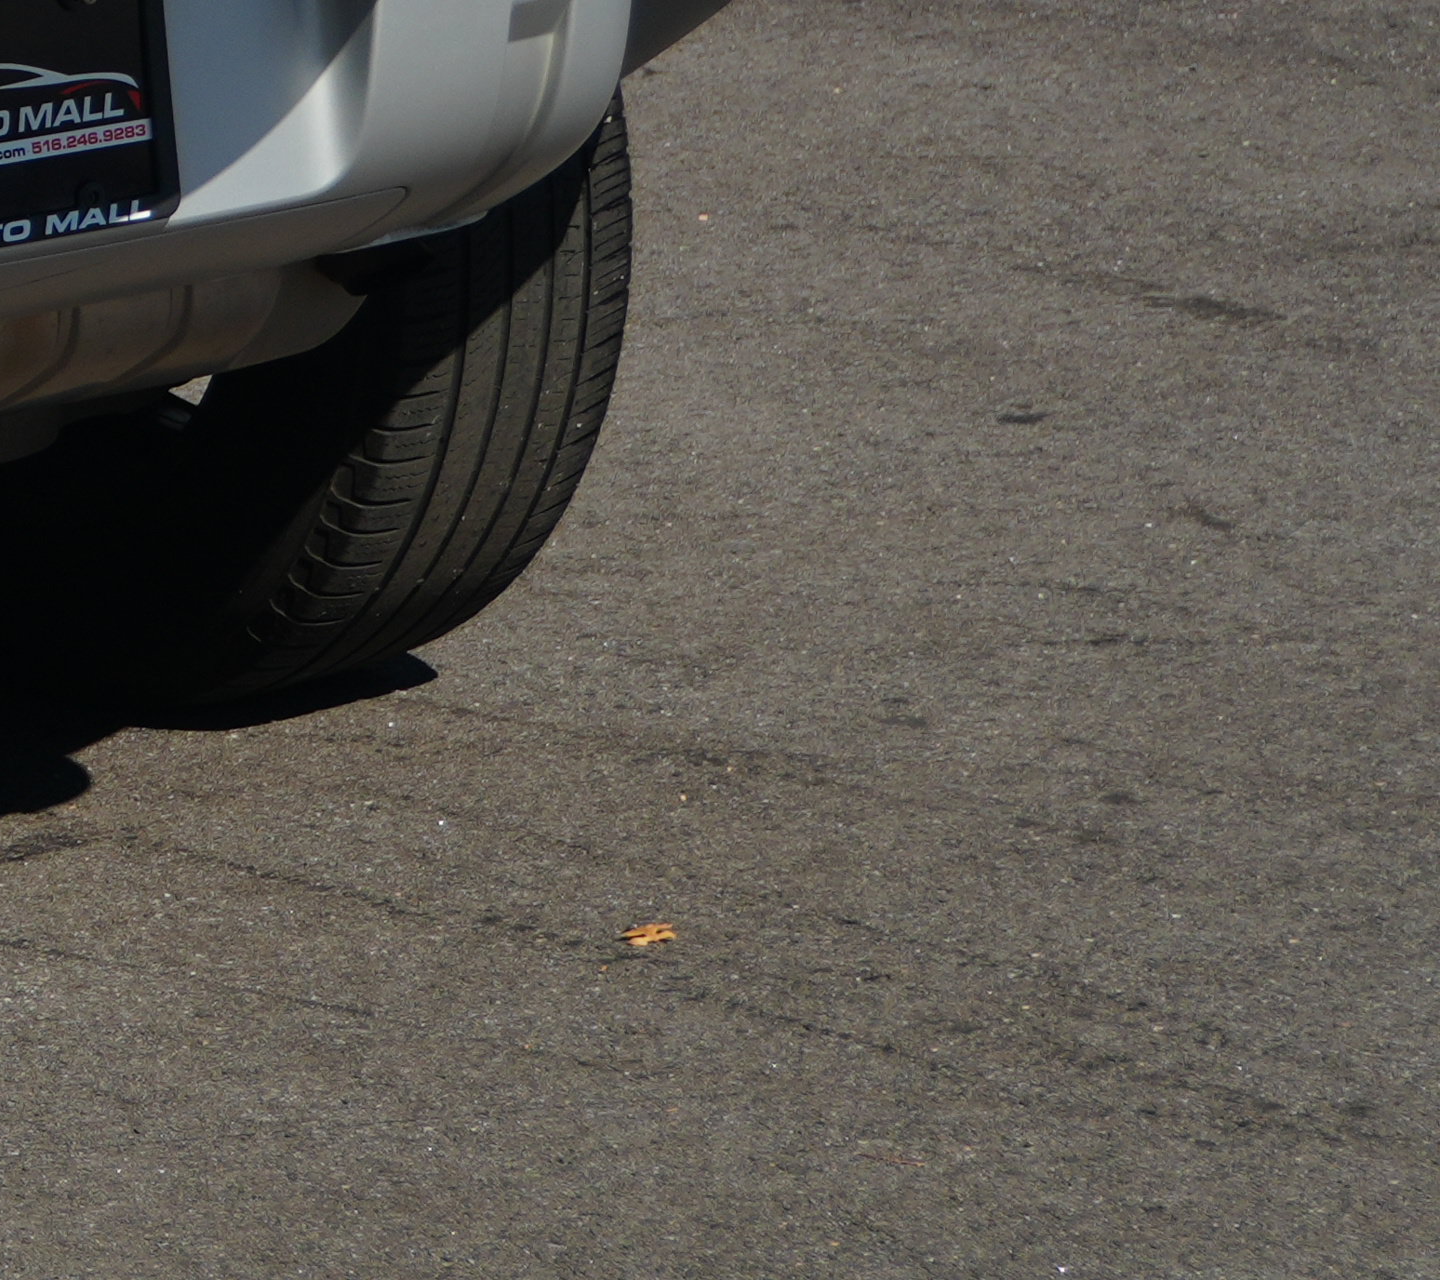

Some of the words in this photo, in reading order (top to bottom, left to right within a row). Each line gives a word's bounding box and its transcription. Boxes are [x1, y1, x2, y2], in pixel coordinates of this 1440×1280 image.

[18, 92, 124, 132] MALL
[32, 124, 147, 154] 516.246.9283
[45, 199, 152, 236] MALL
